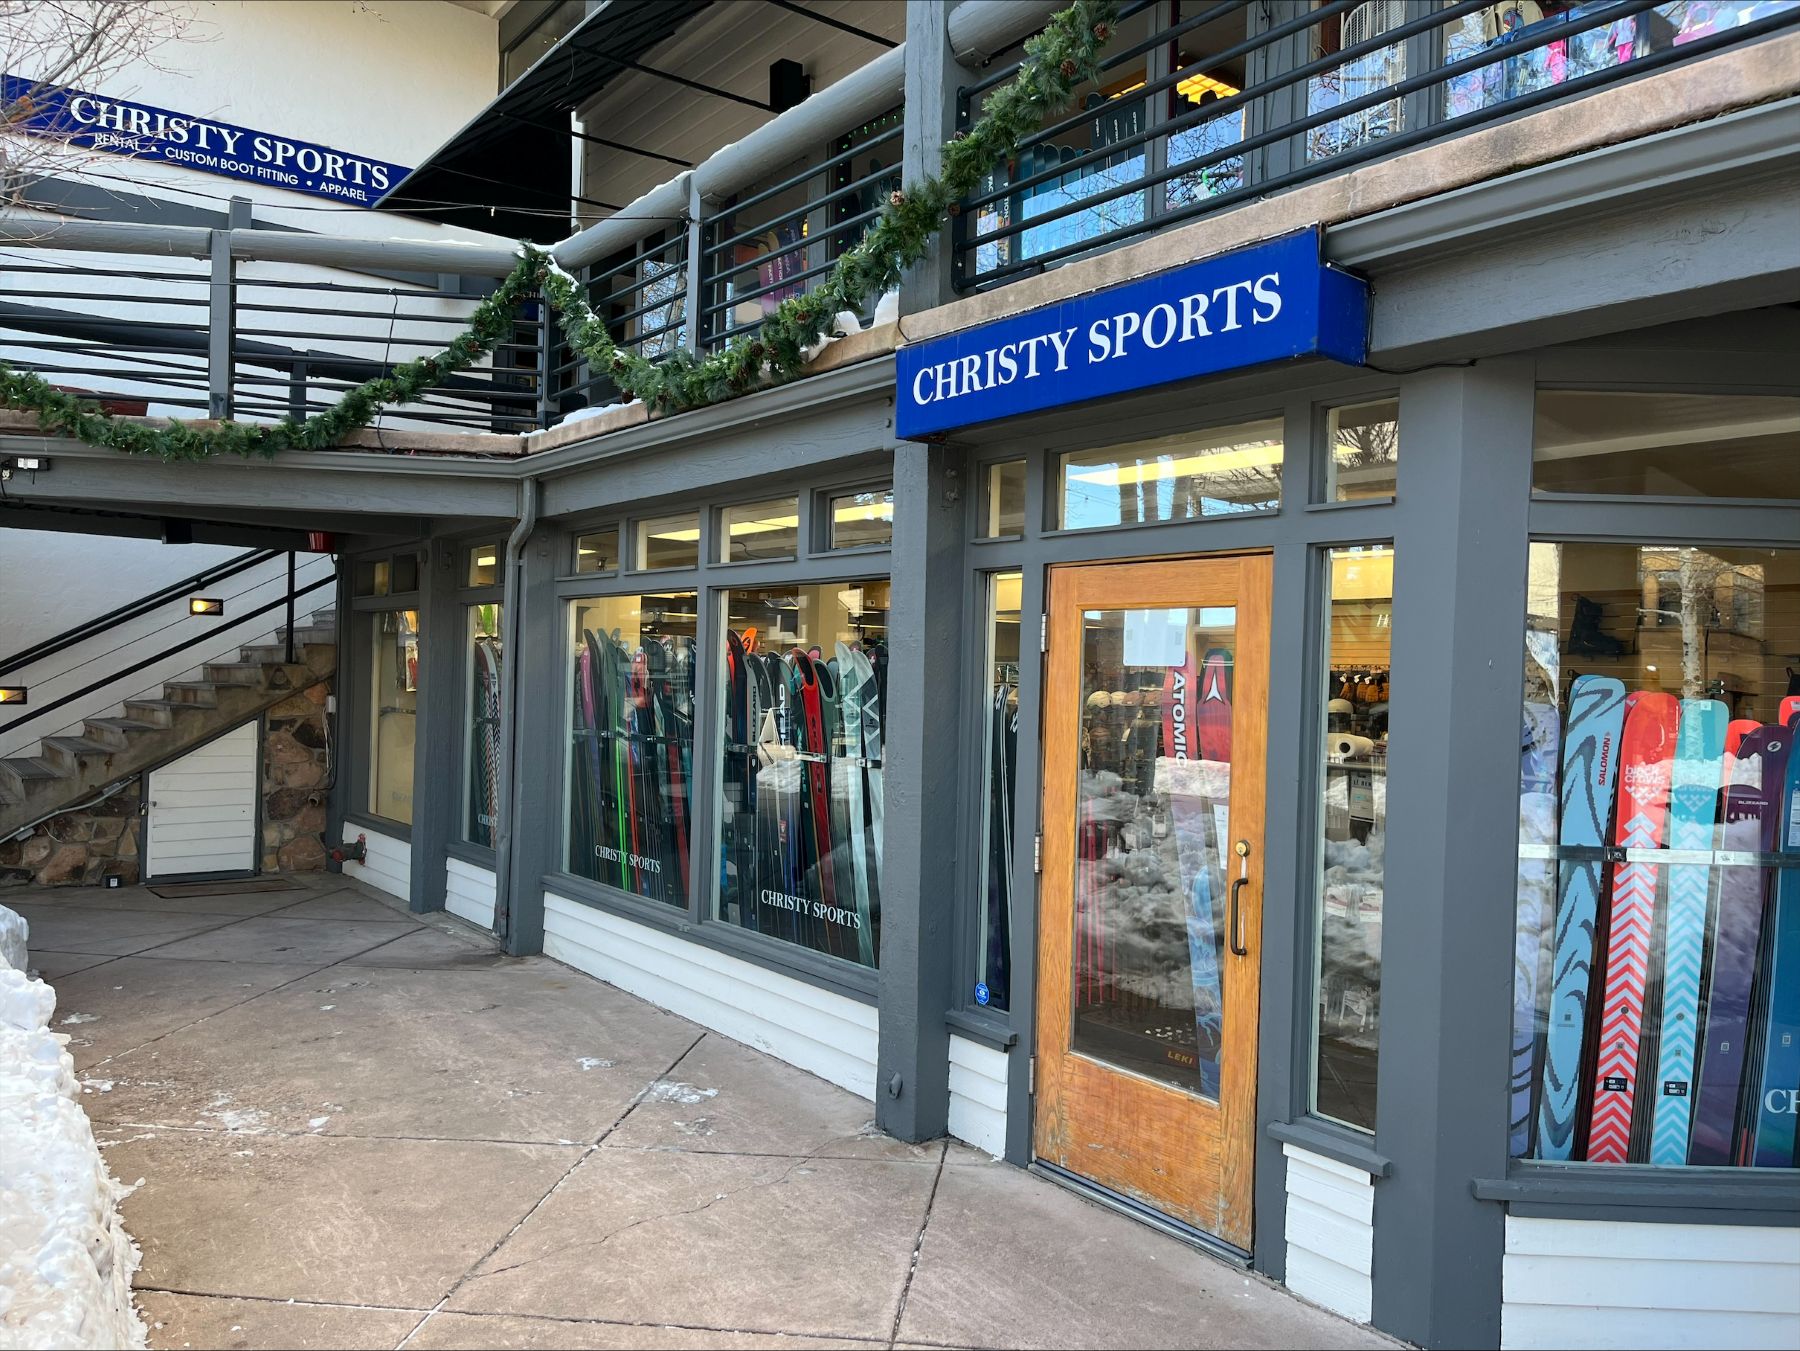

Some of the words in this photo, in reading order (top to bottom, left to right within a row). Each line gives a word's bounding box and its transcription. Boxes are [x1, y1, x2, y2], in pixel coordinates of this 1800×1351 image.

[70, 97, 244, 155] CHRISTY
[253, 137, 389, 190] SPORTS
[95, 133, 142, 151] RENTAL
[165, 146, 218, 167] CUSTOM
[220, 157, 254, 175] BOOT
[257, 166, 299, 185] FITTING
[319, 181, 368, 201] APPAREL
[912, 326, 1077, 406] CHRISTY
[1087, 271, 1283, 365] SPORTS
[1172, 671, 1188, 769] ATOMIC
[1598, 737, 1611, 786] SALOMON
[595, 845, 628, 865] CHRISTY
[629, 853, 661, 874] SPORTS
[761, 889, 811, 915] CHRISTY
[812, 901, 861, 930] SPORTS
[1167, 1050, 1193, 1065] LEKI
